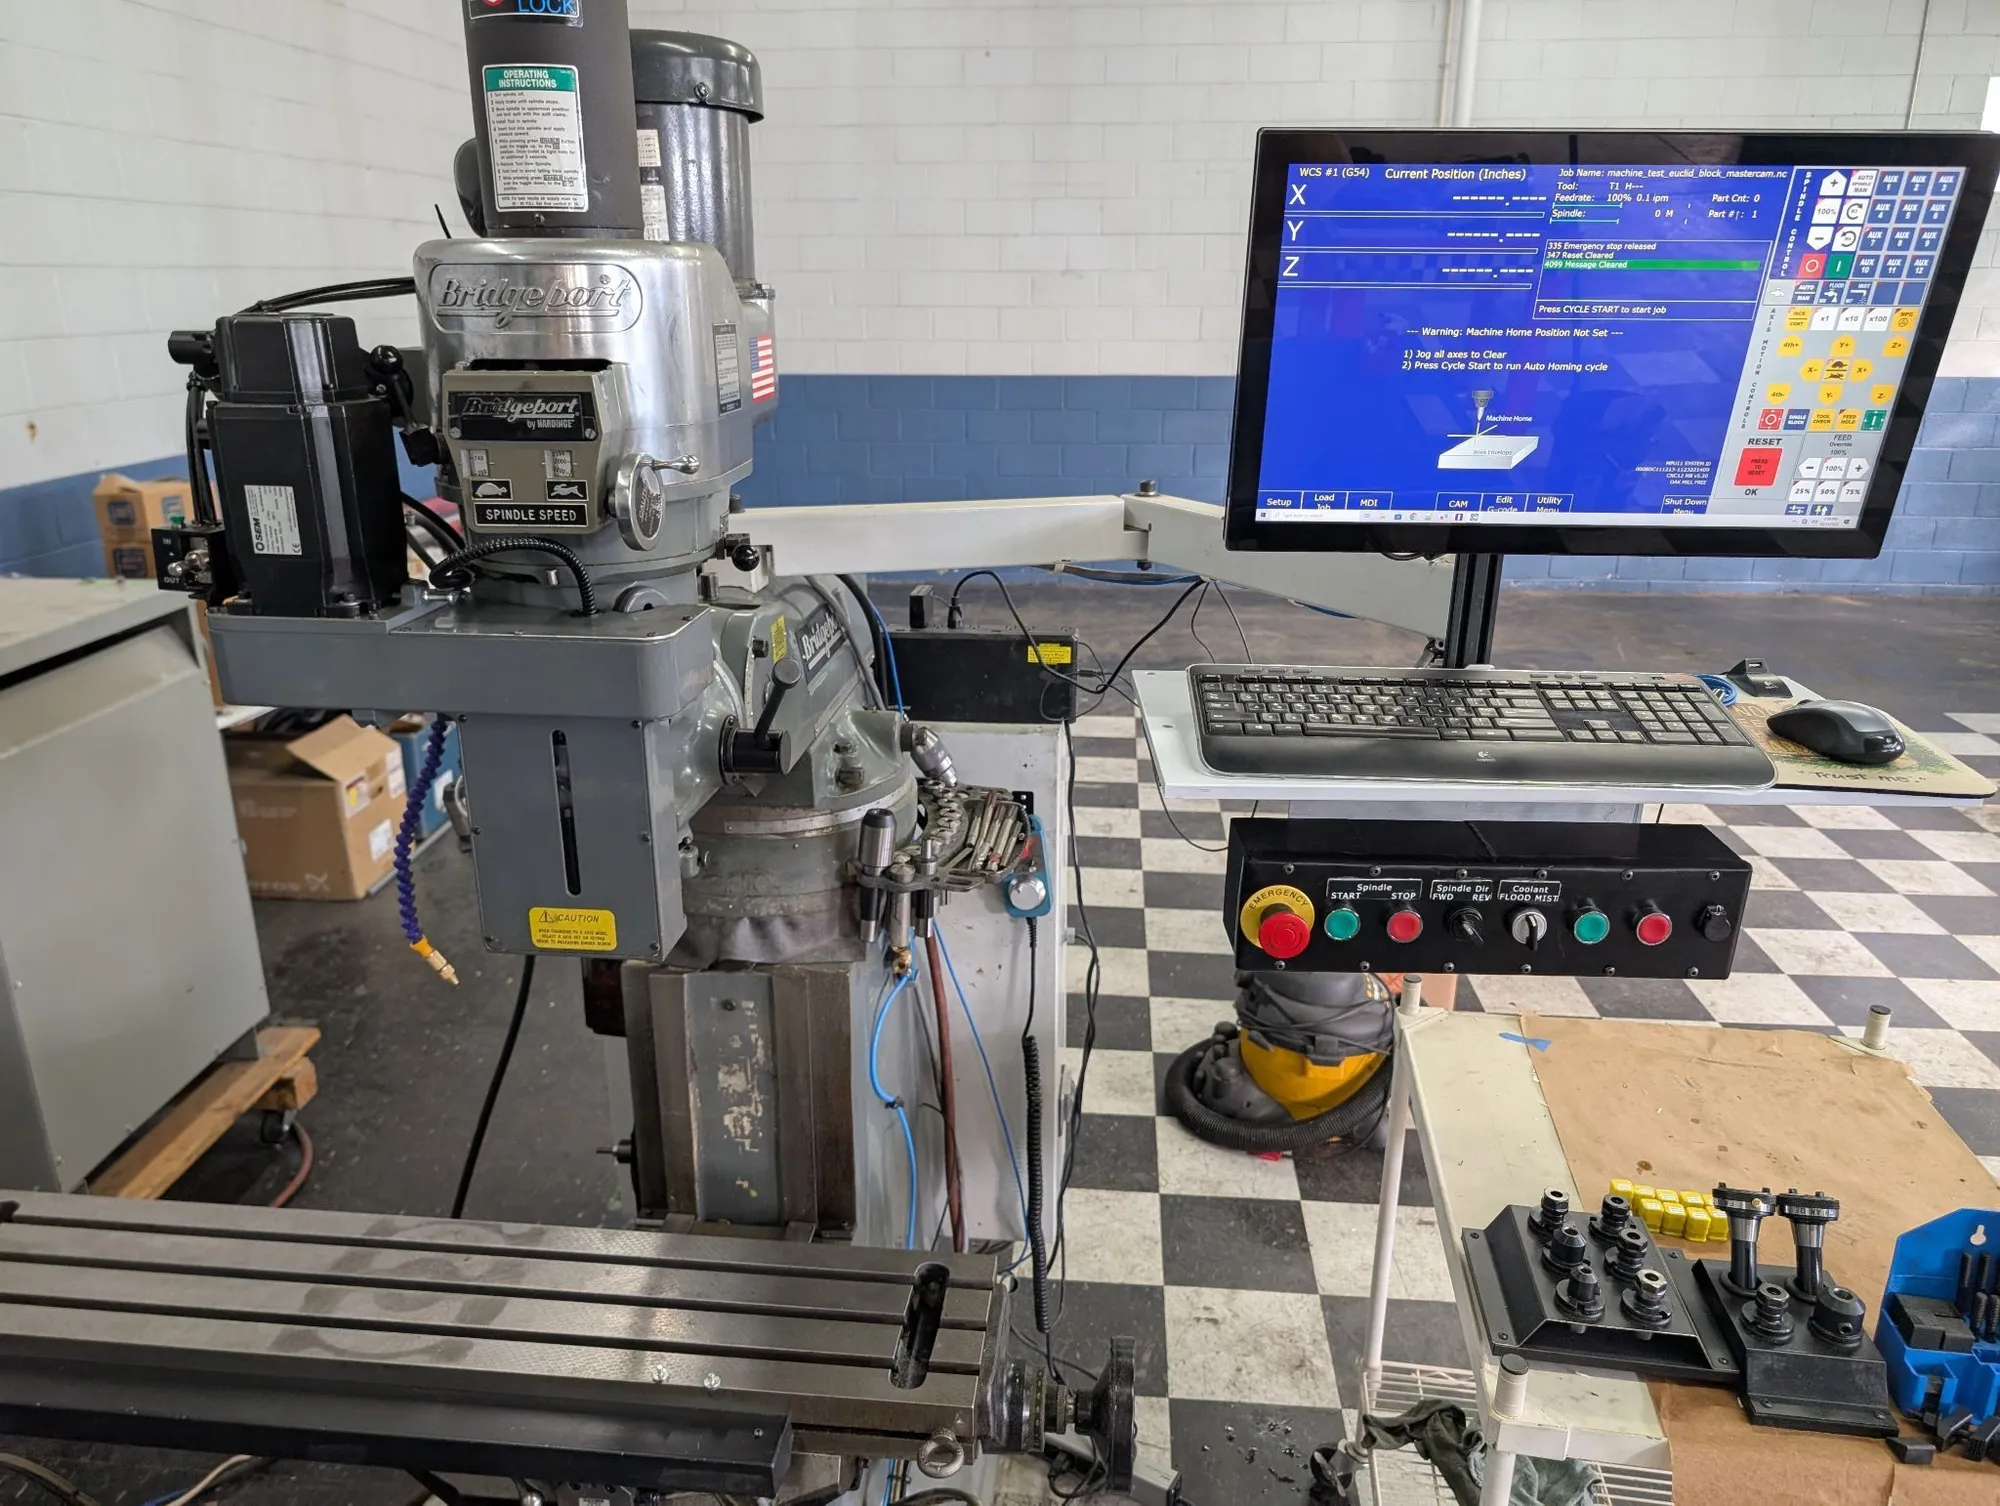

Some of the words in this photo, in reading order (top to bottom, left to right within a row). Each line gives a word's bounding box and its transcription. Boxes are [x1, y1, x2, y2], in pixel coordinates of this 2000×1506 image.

[503, 70, 549, 78] OPERATING
[499, 79, 557, 88] INSTRUCTIONS
[1300, 168, 1322, 177] WCS
[1325, 168, 1338, 177] #1
[1342, 168, 1370, 178] (G54)
[1385, 169, 1428, 179] Current
[1431, 169, 1475, 180] Position
[1478, 169, 1526, 181] (Inches)
[1559, 169, 1573, 177] Job
[1576, 169, 1604, 177] Name:
[1939, 175, 1953, 183] AUX
[1557, 182, 1579, 190] Tool:
[1609, 182, 1619, 190] T1
[1886, 183, 1891, 191] 1
[1913, 183, 1919, 191] 2
[1289, 184, 1307, 204] X
[1554, 194, 1595, 202] Feedrate:
[1607, 194, 1632, 202] 100%
[1652, 194, 1669, 202] ipm
[1712, 194, 1730, 202] Part
[1731, 194, 1749, 202] Cnt:
[1754, 194, 1760, 202] 0
[1875, 203, 1890, 211] AUX
[1903, 203, 1917, 211] AUX
[1930, 203, 1945, 211] AUX
[1552, 209, 1586, 218] Spindle:
[1708, 210, 1727, 218] Part
[1752, 210, 1757, 218] 1
[1287, 220, 1304, 241] Y
[1867, 231, 1882, 239] AUX
[1895, 231, 1909, 239] AUX
[1922, 231, 1937, 239] AUX
[1548, 242, 1562, 250] 335
[1563, 242, 1605, 251] Emergency
[1606, 243, 1622, 251] stop
[1624, 242, 1656, 250] released
[1283, 256, 1300, 277] Z
[1564, 261, 1597, 269] Message
[1915, 266, 1923, 274] 12
[436, 275, 631, 328] Bridgeport
[1539, 305, 1561, 313] Press
[1563, 305, 1589, 313] CYCLE
[1592, 305, 1619, 313] START
[1652, 306, 1666, 315] job
[1422, 327, 1463, 337] Warning:
[1466, 328, 1503, 336] Machine
[1506, 328, 1532, 336] Home
[1535, 328, 1570, 337] Position
[1573, 329, 1590, 337] Not
[1593, 329, 1608, 337] Set
[1403, 350, 1413, 359] 1)
[1416, 350, 1431, 360] Jog
[1433, 350, 1444, 358] all
[1447, 351, 1468, 359] axes
[1483, 351, 1507, 359] Clear
[1402, 362, 1412, 370] 2)
[1414, 362, 1439, 370] Press
[1441, 362, 1465, 371] Cycle
[1468, 362, 1491, 370] Start
[1493, 362, 1503, 370] to
[1524, 362, 1545, 371] Auto
[1548, 363, 1582, 372] Homing
[1585, 363, 1608, 371] cycle
[463, 397, 579, 422] Bridgeport
[527, 420, 536, 430] by
[1748, 438, 1782, 446] RESET
[1266, 498, 1292, 507] Setup
[1360, 499, 1378, 507] MDI
[1448, 500, 1468, 508] CAM
[1495, 496, 1513, 504] Edit
[1537, 496, 1562, 505] Utility
[1685, 498, 1707, 506] Down
[486, 509, 536, 520] SPINDLE
[539, 510, 576, 521] SPEED
[1357, 883, 1393, 893] Spindle
[1437, 884, 1472, 893] Spindle
[1475, 885, 1490, 893] Dir
[1512, 885, 1549, 894] Coolant
[1248, 889, 1309, 911] EMERGENCY
[1391, 892, 1416, 900] STOP
[1534, 894, 1558, 902] MIST
[558, 914, 600, 922] CAUTION
